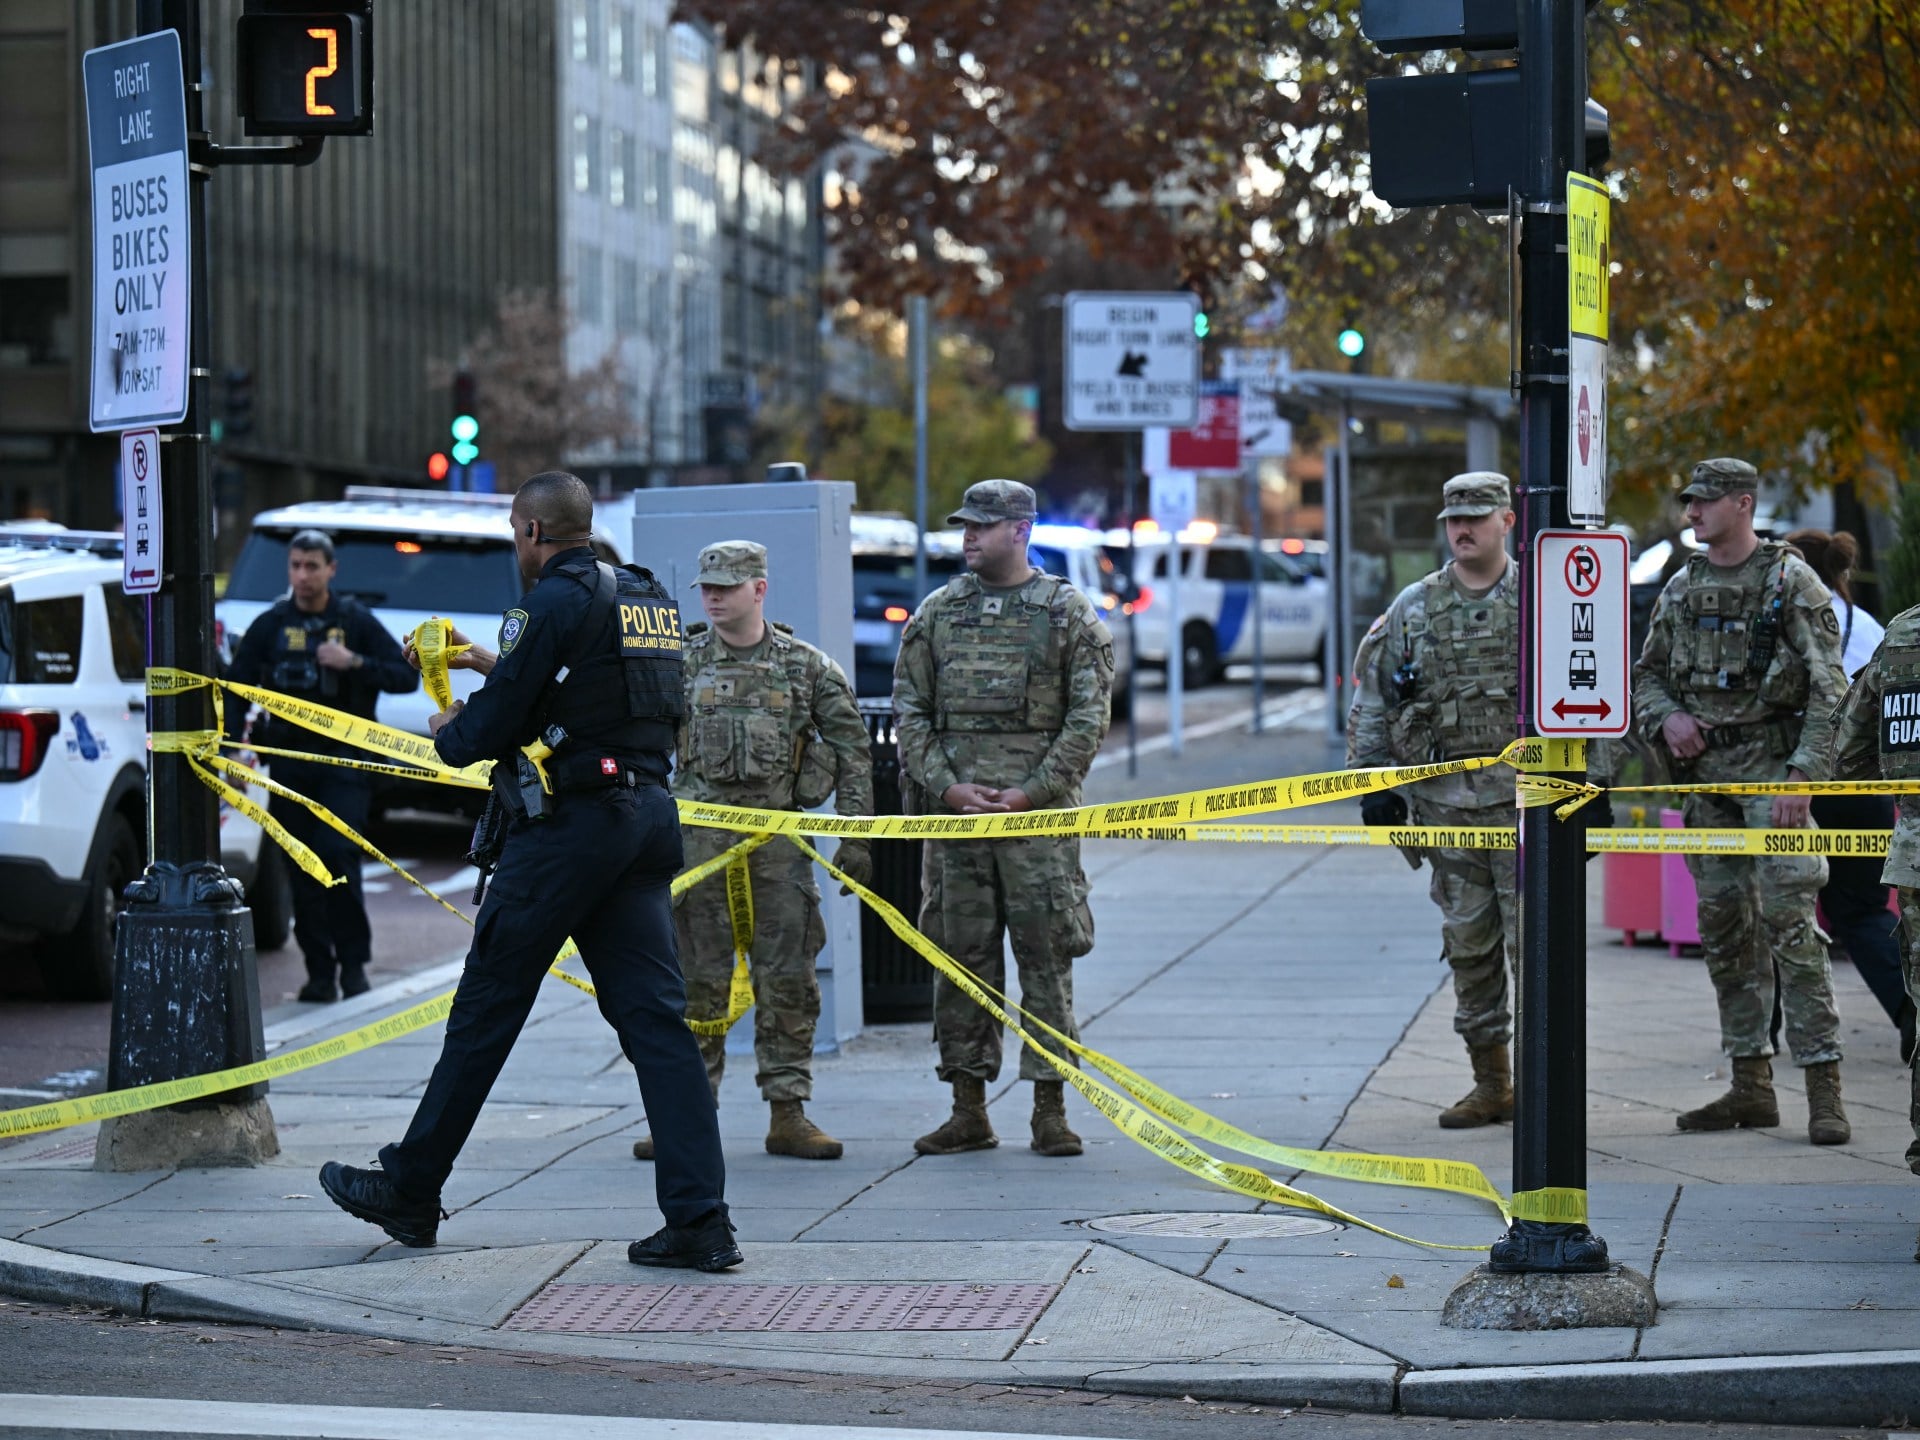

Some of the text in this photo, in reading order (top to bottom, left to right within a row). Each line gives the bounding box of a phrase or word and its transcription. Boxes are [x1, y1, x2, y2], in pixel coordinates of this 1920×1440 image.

[114, 62, 150, 98] RIGHT
[306, 28, 337, 116] 2
[119, 110, 153, 145] LANE
[111, 175, 168, 222] BUSES
[113, 225, 169, 271] BIKES
[115, 271, 167, 316] ONLY
[619, 604, 681, 638] POLICE
[1573, 604, 1592, 631] M
[623, 635, 658, 649] HOMELAND
[658, 638, 682, 652] SECURITY
[1573, 631, 1592, 639] metro
[283, 700, 297, 716] DO
[295, 705, 312, 719] NOT
[311, 709, 335, 729] CROSS
[364, 727, 390, 748] POLICE
[388, 735, 406, 752] LINE
[403, 740, 416, 755] DO
[412, 742, 430, 760] NOT
[1303, 772, 1372, 797] POLICE LINE DO NOT CROSS
[1205, 786, 1277, 812] POLICE LINE DO NOT CROSS
[692, 808, 771, 827] POLICE LINE DO NOT CROSS
[1002, 812, 1079, 830] POLICE LINE DO NOT CROSS
[1104, 800, 1179, 823] POLICE LINE DO NOT CROSS
[795, 818, 875, 832] POLICE LINE DO NOT CROSS
[899, 819, 977, 832] POLICE LINE DO NOT CROSS
[1147, 827, 1186, 841] CRIME
[1390, 831, 1428, 847] CROSS
[1433, 832, 1455, 847] NOT
[1460, 832, 1475, 847] DO
[1764, 834, 1804, 853] CROSS
[1808, 834, 1831, 853] NOT
[1835, 834, 1851, 853] DO
[1096, 1091, 1121, 1120] POLICE
